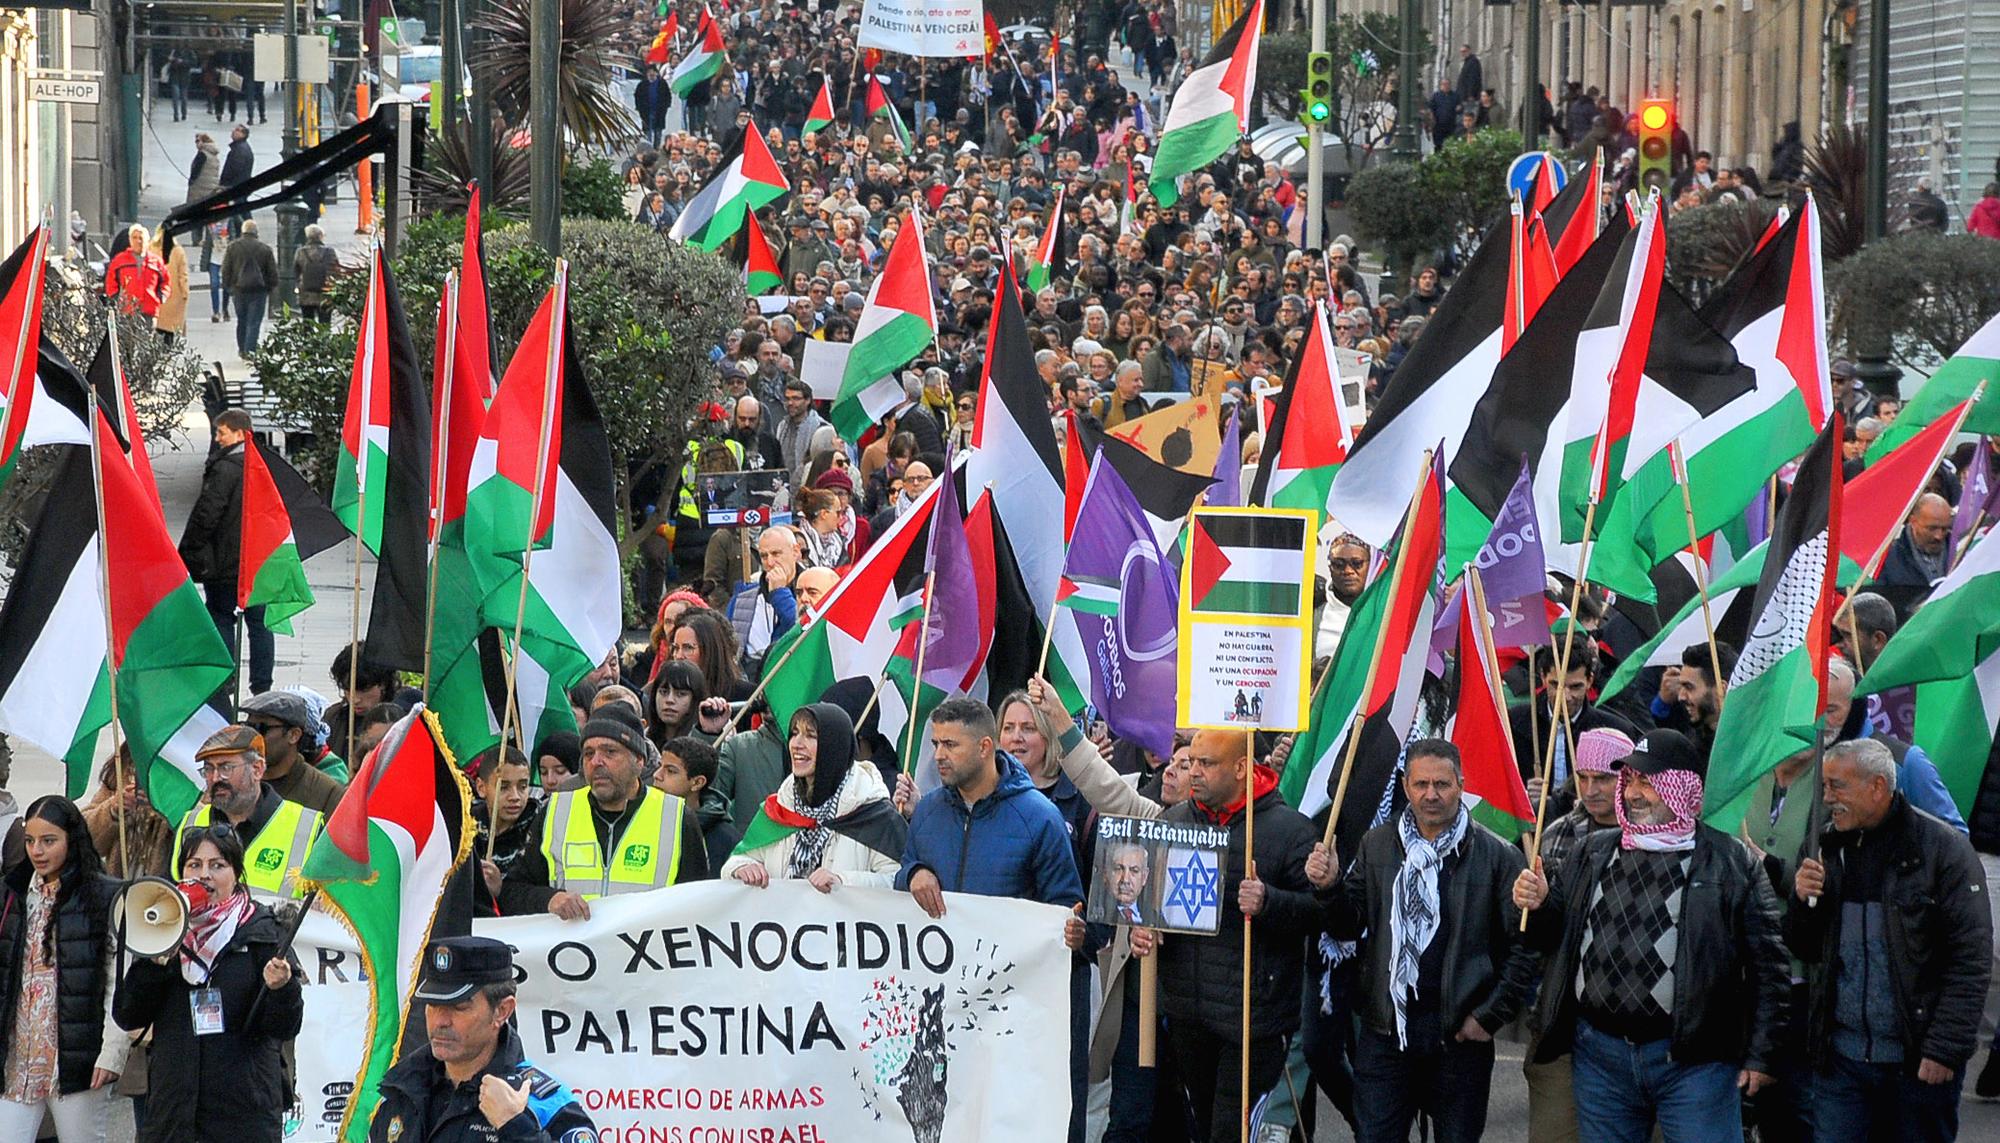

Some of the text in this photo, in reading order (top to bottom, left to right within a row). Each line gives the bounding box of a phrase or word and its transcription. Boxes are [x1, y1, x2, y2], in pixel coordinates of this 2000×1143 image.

[878, 3, 904, 15] Dende
[868, 15, 979, 34] PALESTINA VENCERÁ!
[35, 84, 94, 97] ALE-HOP
[1235, 631, 1271, 639] PALESTINA
[1219, 642, 1230, 650] NO
[1101, 614, 1126, 699] ODEMOS
[1209, 666, 1224, 674] HAY
[1099, 817, 1229, 848] Heil Netanyahu
[547, 940, 598, 982] O
[617, 920, 954, 975] XENOCIDIO
[541, 1000, 846, 1057] PALESTINA
[709, 1088, 732, 1111] DE
[739, 1085, 825, 1111] ARMAS
